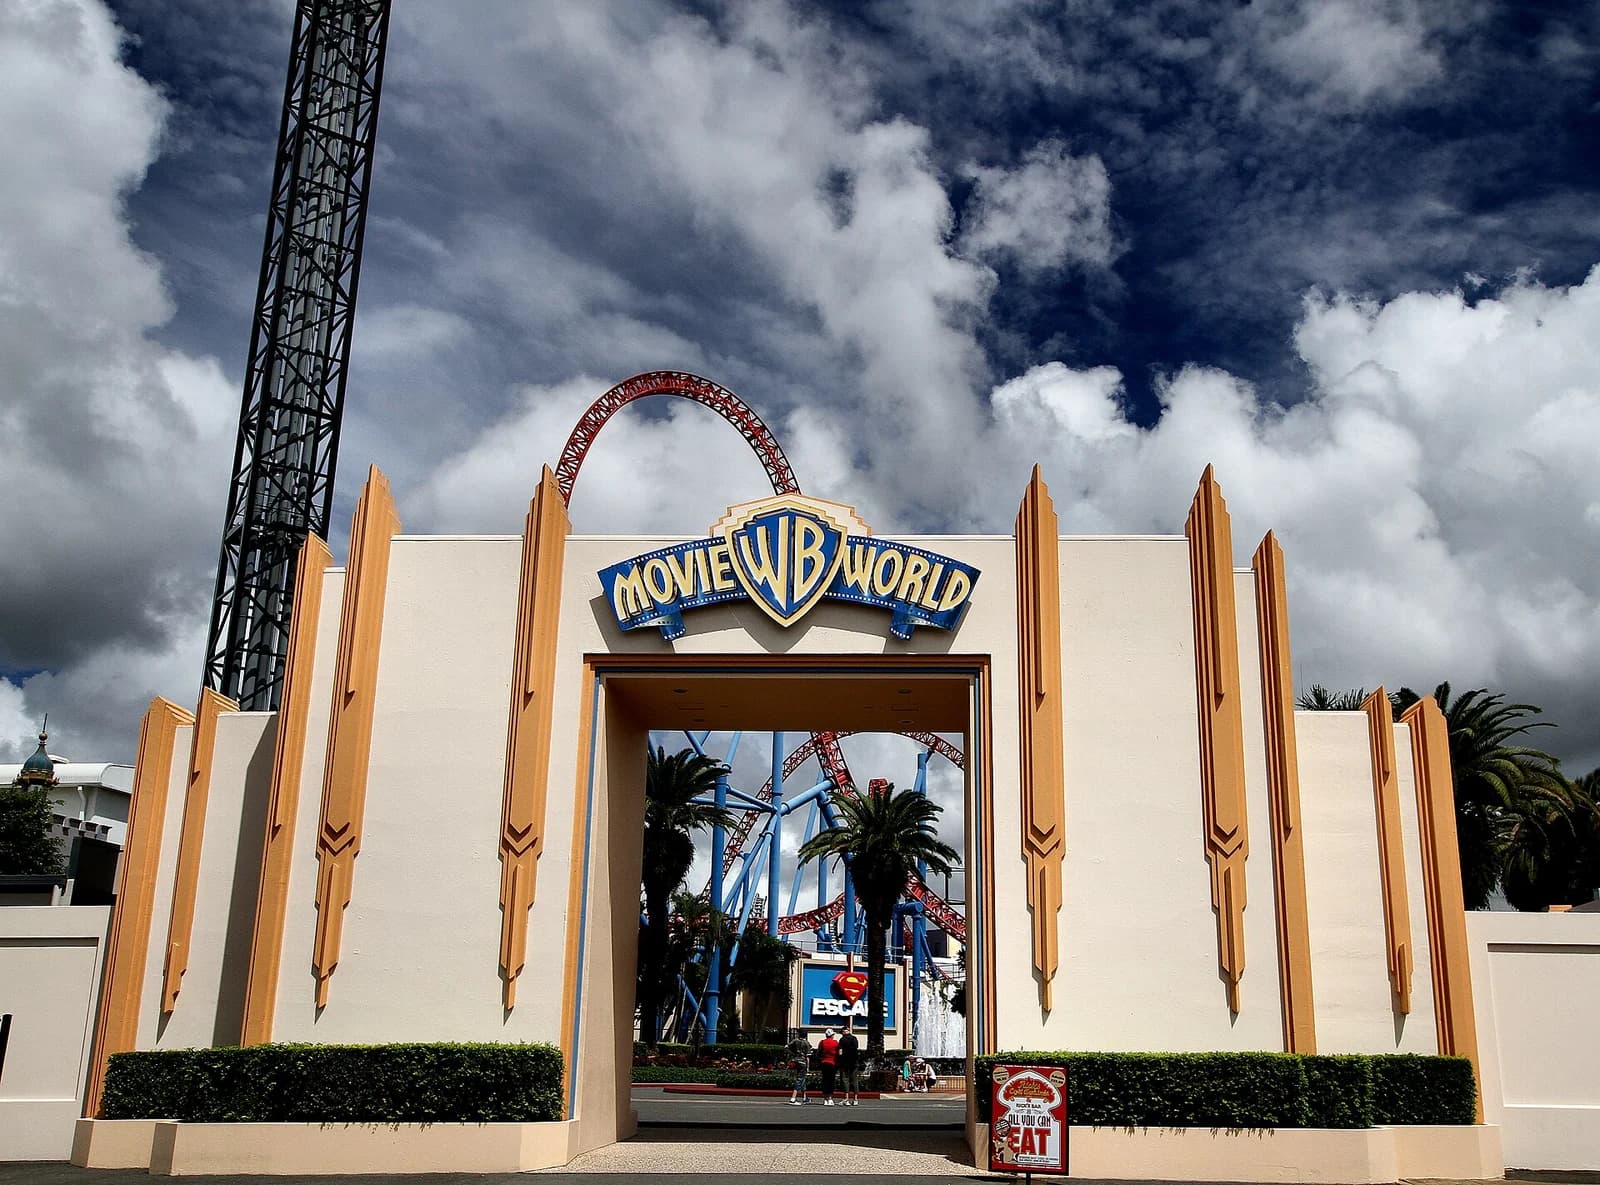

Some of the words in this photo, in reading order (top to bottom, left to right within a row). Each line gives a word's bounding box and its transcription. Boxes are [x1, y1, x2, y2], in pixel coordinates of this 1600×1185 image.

[739, 515, 826, 611] WB
[613, 546, 737, 621] MOVIE
[842, 543, 971, 612] WORLD
[812, 998, 889, 1017] ESCA
[1009, 1114, 1020, 1126] ALL
[1021, 1114, 1035, 1126] YOU
[1037, 1115, 1051, 1127] CAN
[1010, 1127, 1052, 1156] EAT
